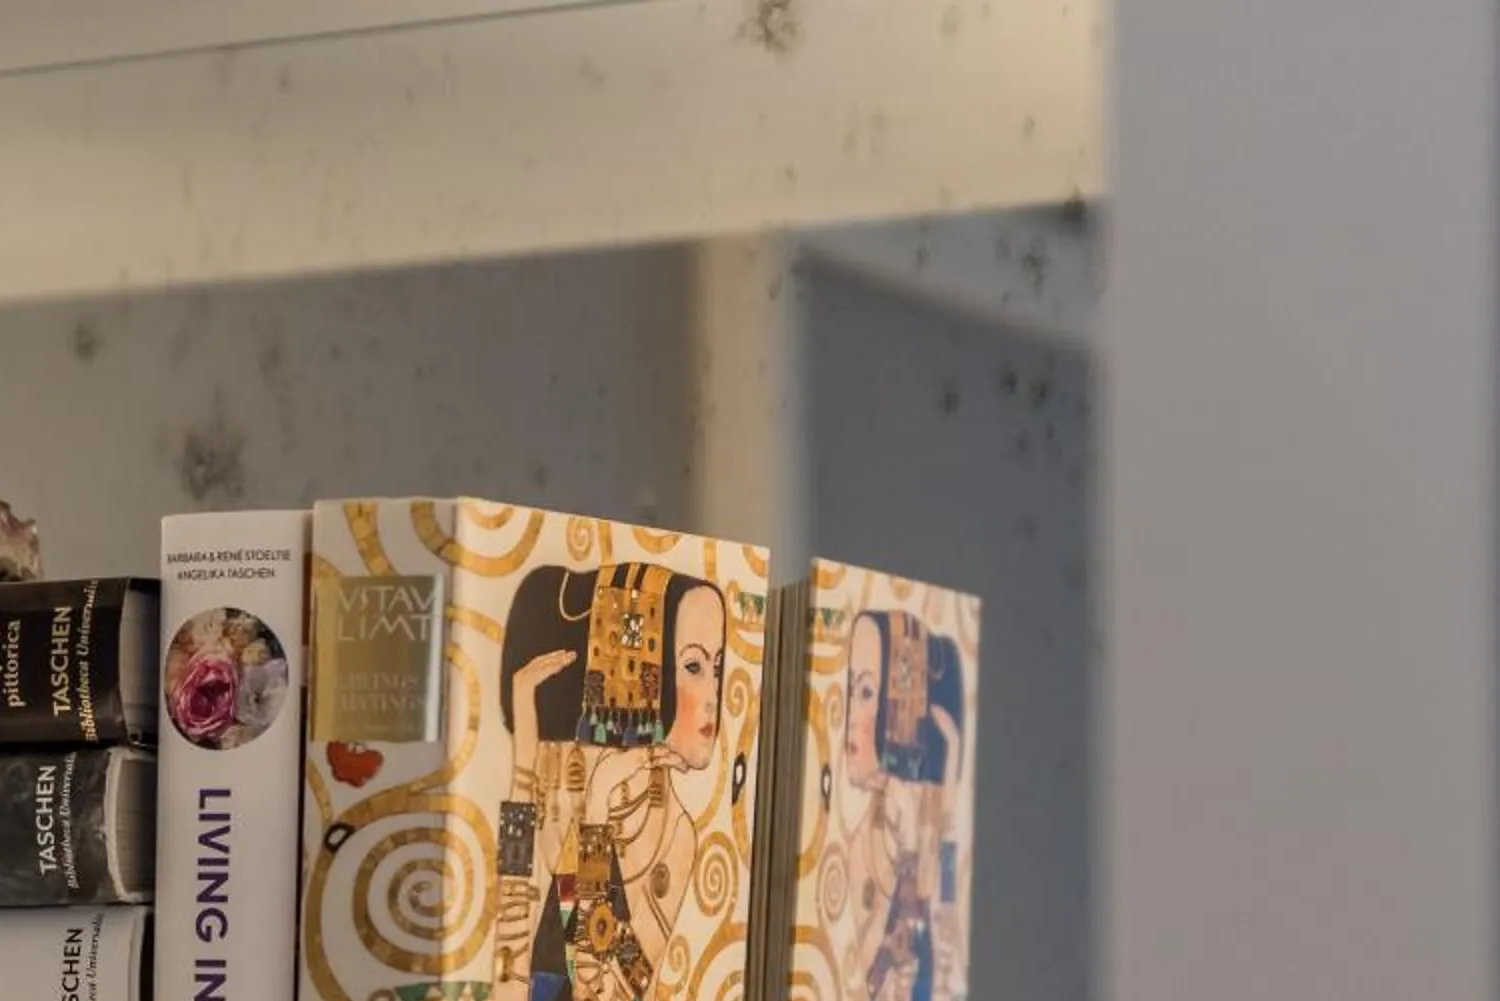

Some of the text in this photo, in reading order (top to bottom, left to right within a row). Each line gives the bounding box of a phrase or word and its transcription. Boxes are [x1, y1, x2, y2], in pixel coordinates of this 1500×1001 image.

[226, 566, 276, 580] TASCHEN
[2, 619, 26, 708] pittorica
[51, 606, 73, 717] TASCHEN
[337, 613, 432, 641] LIMT
[35, 764, 57, 876] TASCHEN
[194, 787, 232, 944] LIVING
